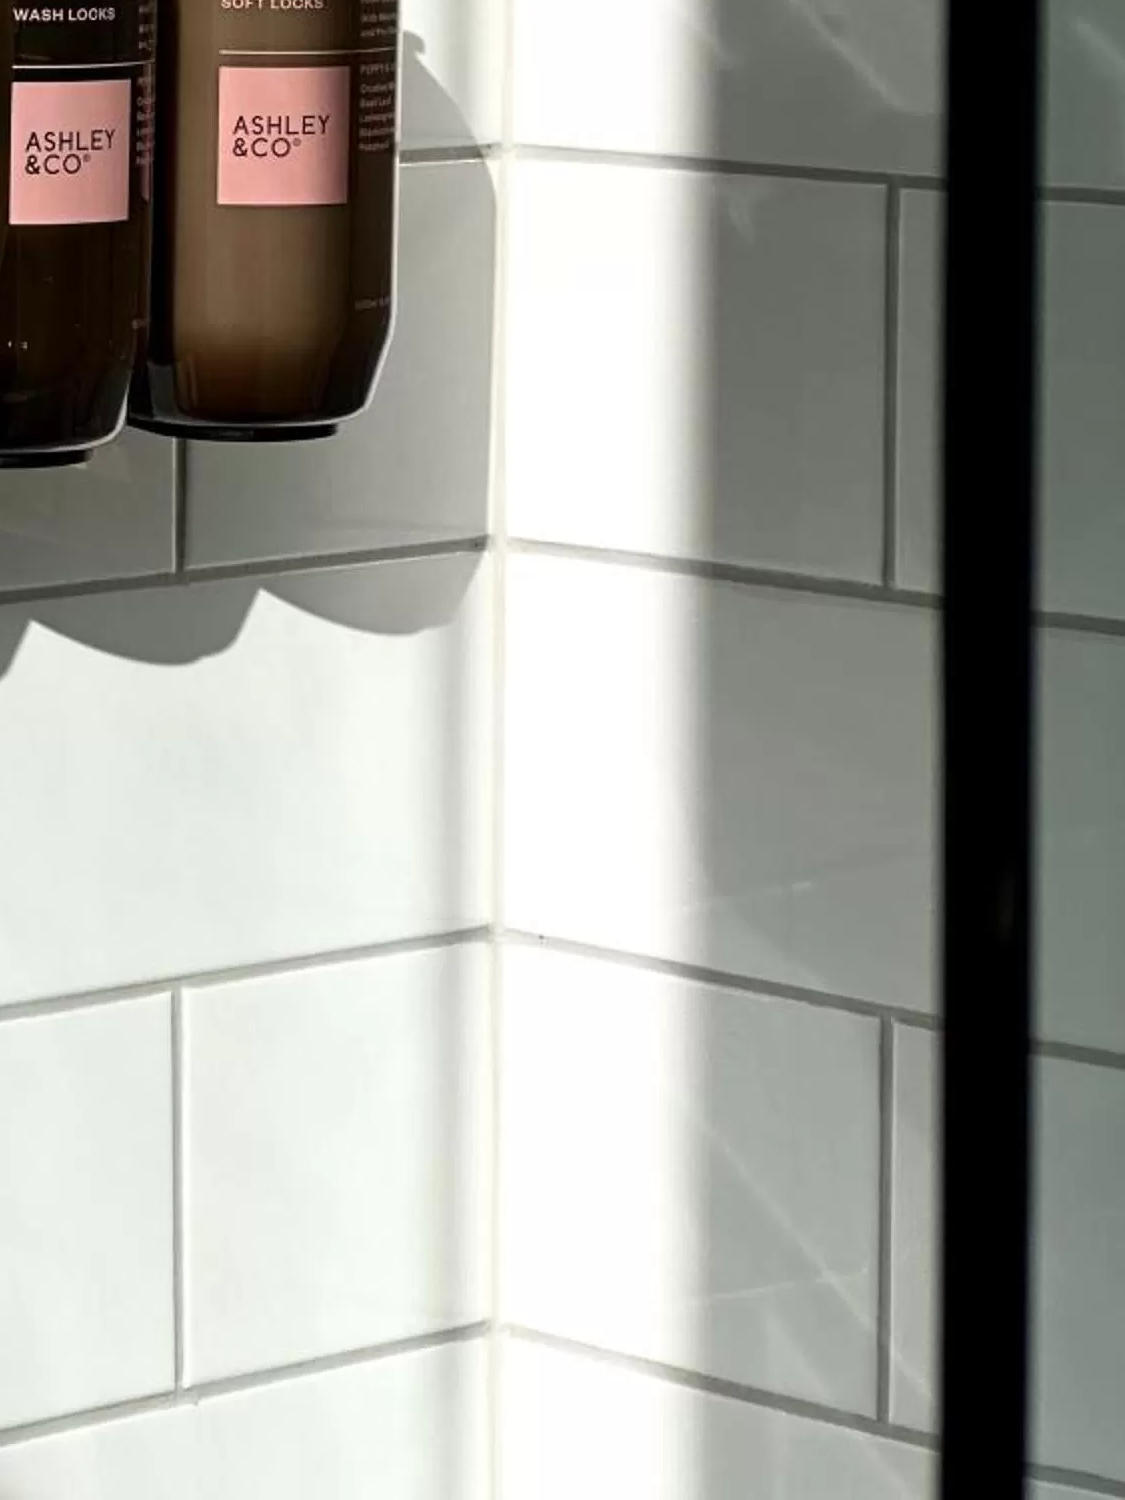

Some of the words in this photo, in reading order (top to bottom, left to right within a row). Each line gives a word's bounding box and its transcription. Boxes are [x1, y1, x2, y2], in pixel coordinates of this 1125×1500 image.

[12, 7, 64, 21] WASH
[68, 7, 116, 21] LOCKS
[232, 114, 331, 136] ASHLEY
[25, 128, 116, 153] ASHLEY
